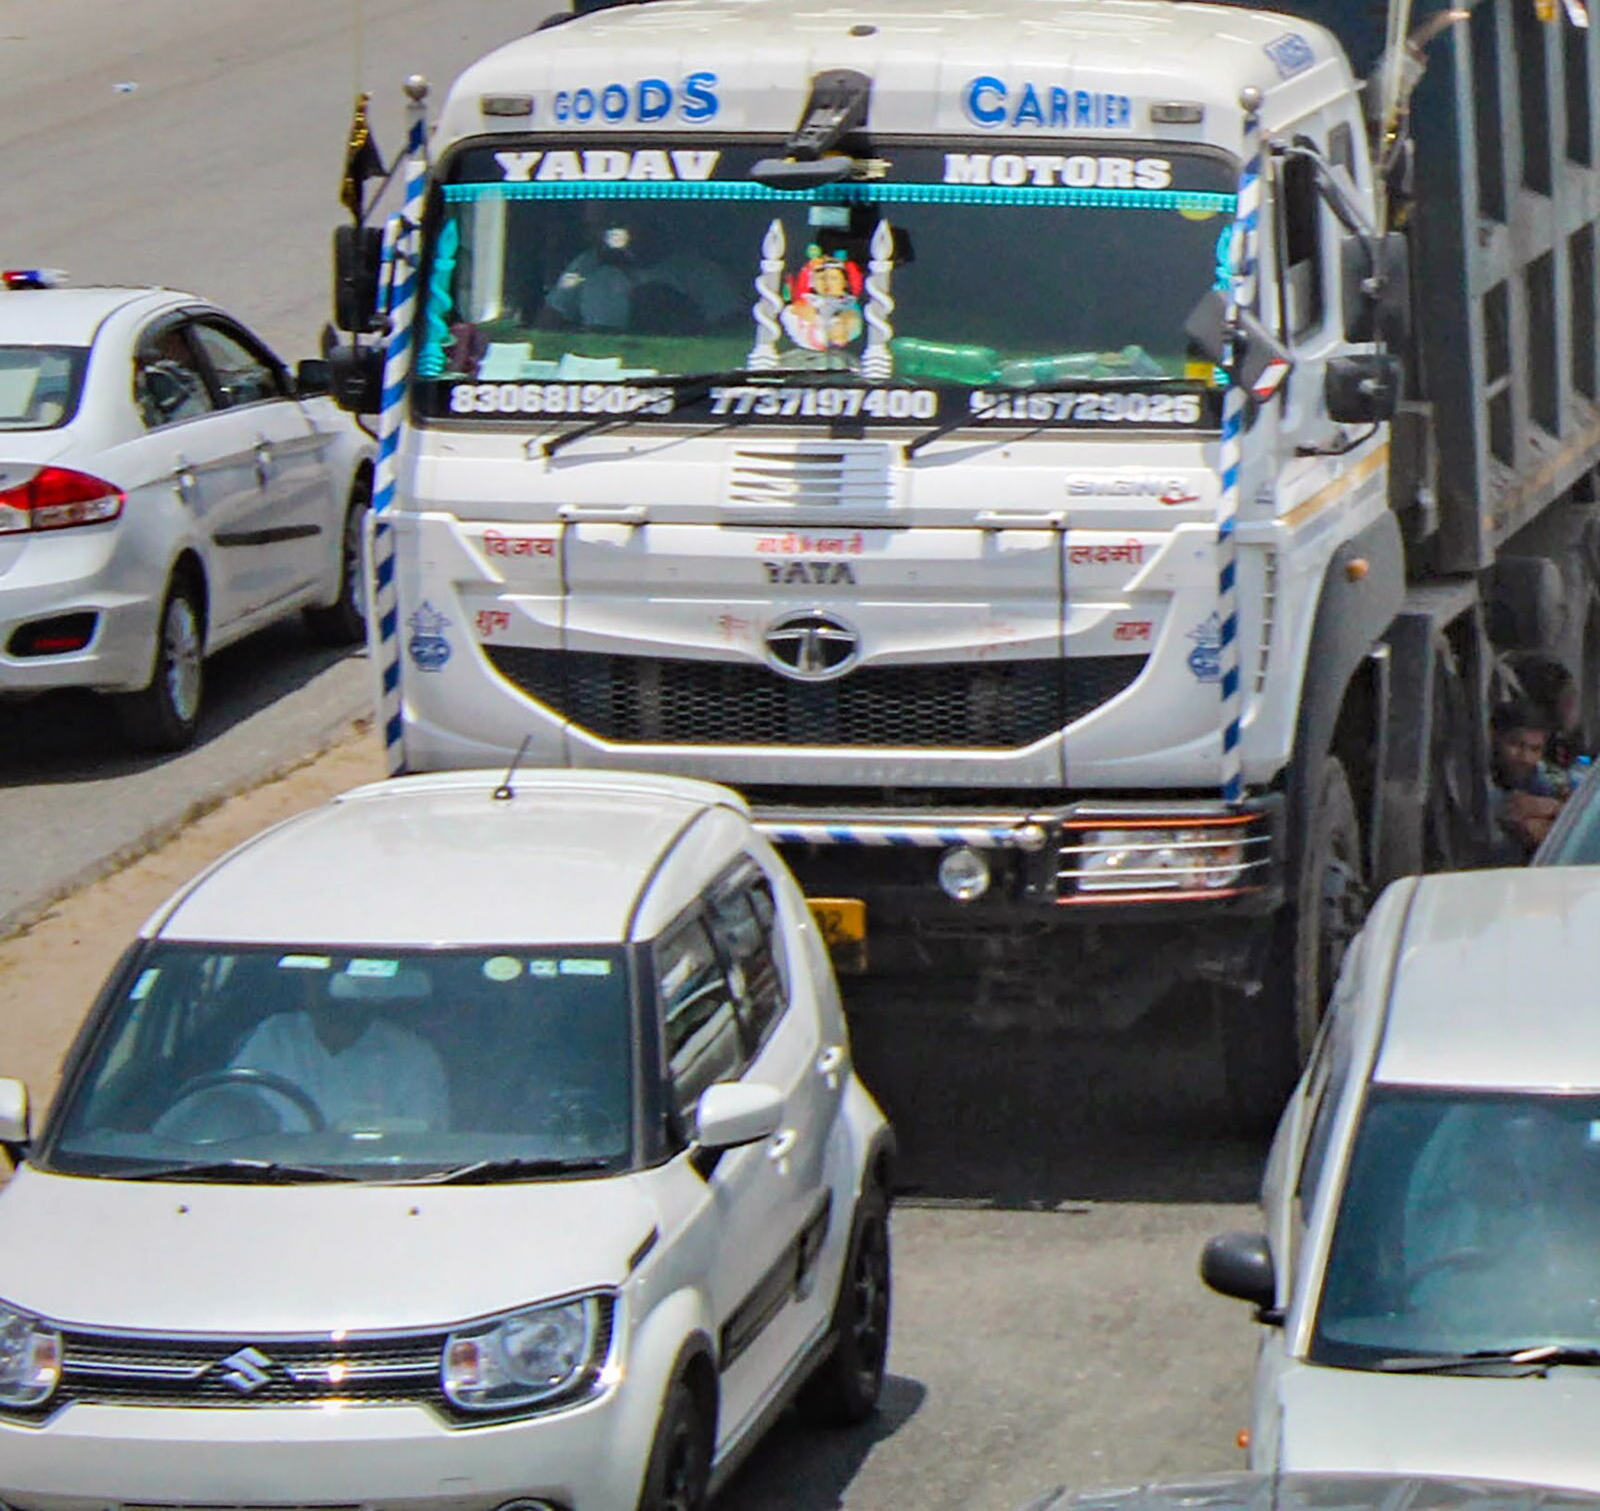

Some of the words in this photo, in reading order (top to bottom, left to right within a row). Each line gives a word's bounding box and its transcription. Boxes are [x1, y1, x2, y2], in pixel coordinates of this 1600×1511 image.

[553, 71, 720, 124] GOODS
[965, 75, 1132, 129] CARRIER
[493, 150, 722, 182] YADAV
[943, 153, 1173, 189] MOTORS
[709, 387, 937, 419] 7737197400
[483, 529, 556, 557] विजय
[763, 561, 857, 585] TATA
